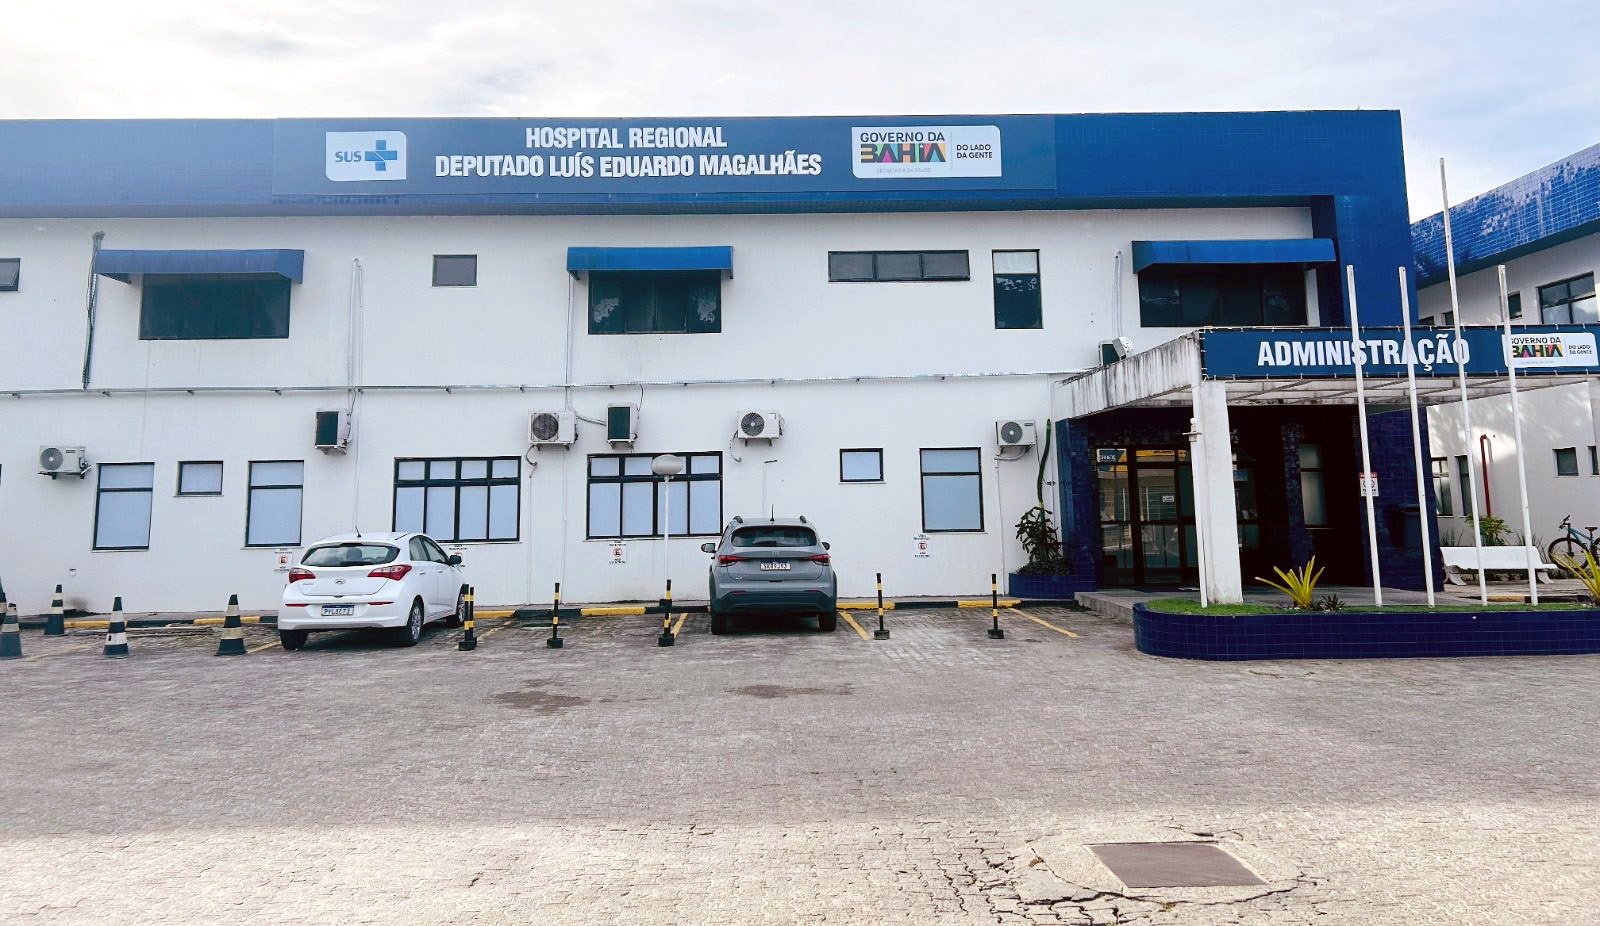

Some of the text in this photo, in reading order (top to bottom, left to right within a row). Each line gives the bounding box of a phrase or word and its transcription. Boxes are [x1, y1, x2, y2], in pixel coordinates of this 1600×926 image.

[525, 126, 728, 149] HOSPITAL REGIONAL
[860, 131, 945, 143] GOVERNO DA
[860, 143, 946, 163] BAHIA
[969, 151, 993, 159] GENTE
[970, 143, 991, 151] LADO
[335, 150, 362, 163] SUS
[435, 149, 823, 178] DEPUTADO LUÍS EDUARDO MAGALHÃES
[1257, 333, 1471, 371] ADMINISTRAÇÃO
